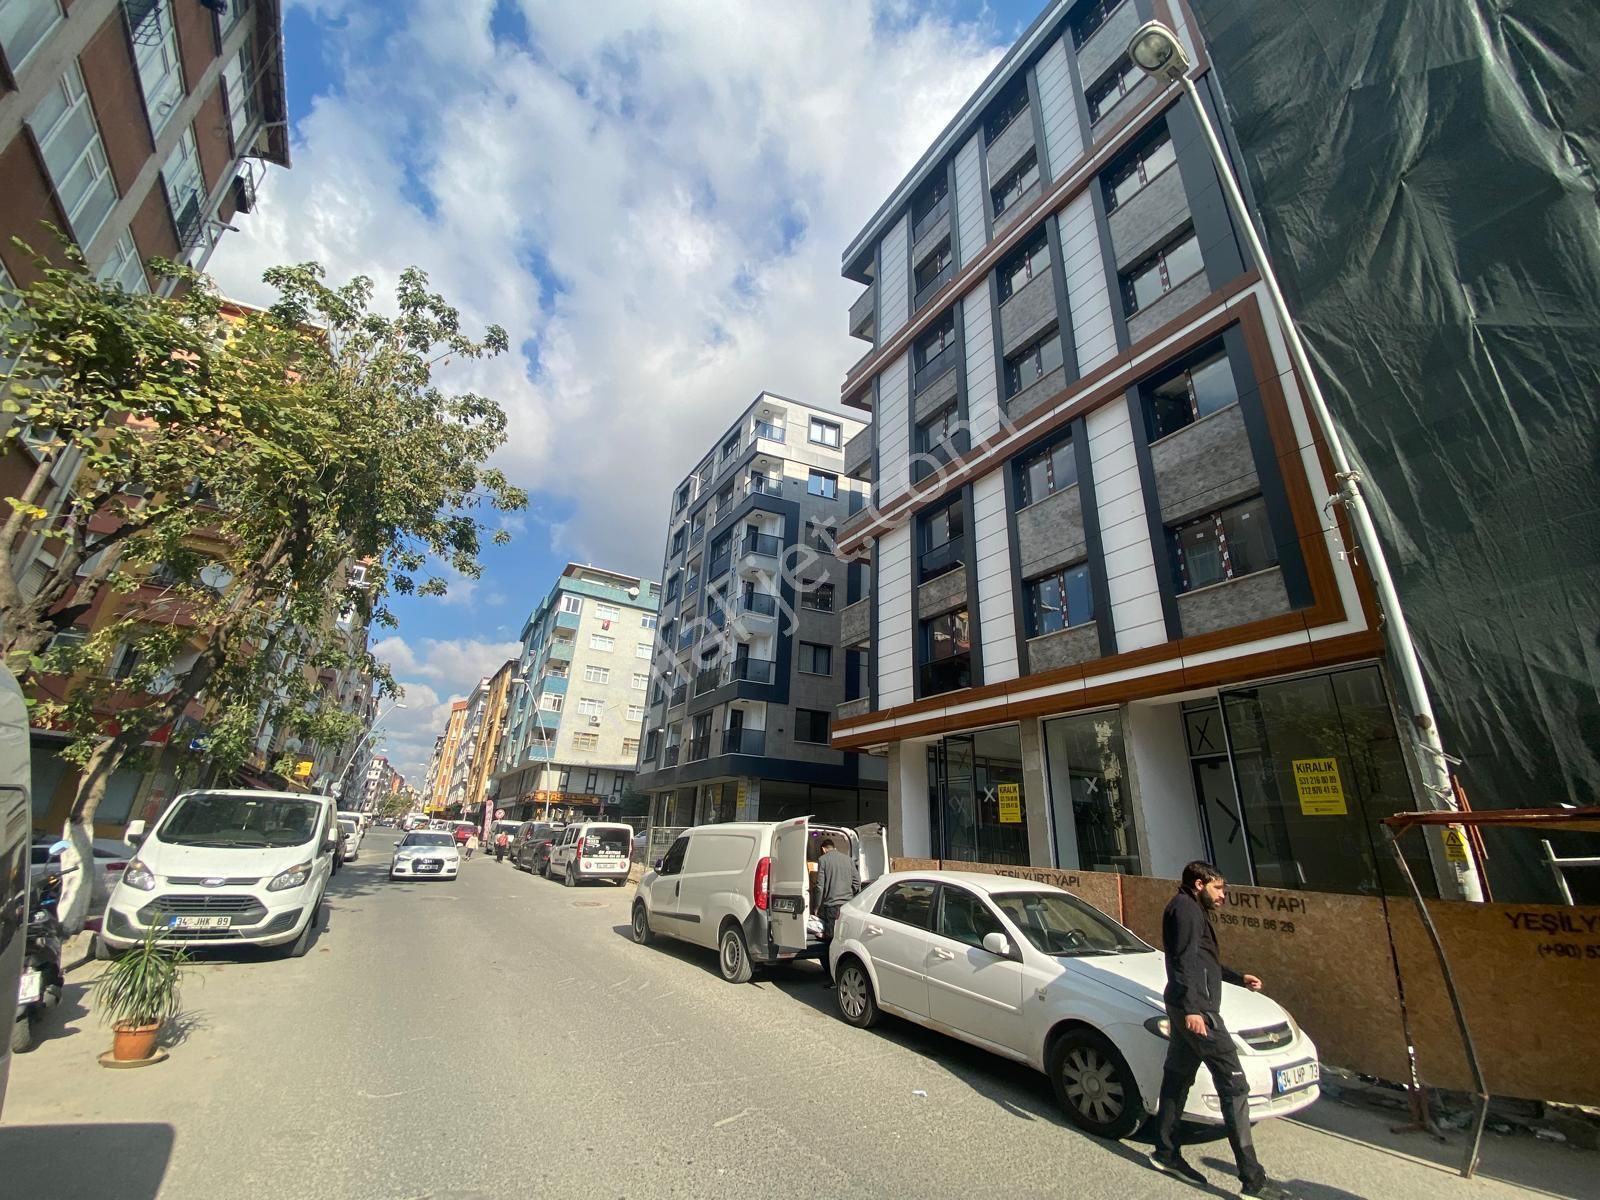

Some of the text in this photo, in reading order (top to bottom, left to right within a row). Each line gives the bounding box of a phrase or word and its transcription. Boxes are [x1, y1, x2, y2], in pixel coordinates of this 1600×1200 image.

[1051, 874, 1080, 887] YAPI
[1265, 895, 1306, 914] YAPI
[1220, 913, 1238, 925] 536
[1504, 911, 1600, 935] YEŞİLY
[1537, 943, 1582, 960] (+90)
[1281, 1071, 1291, 1087] 34
